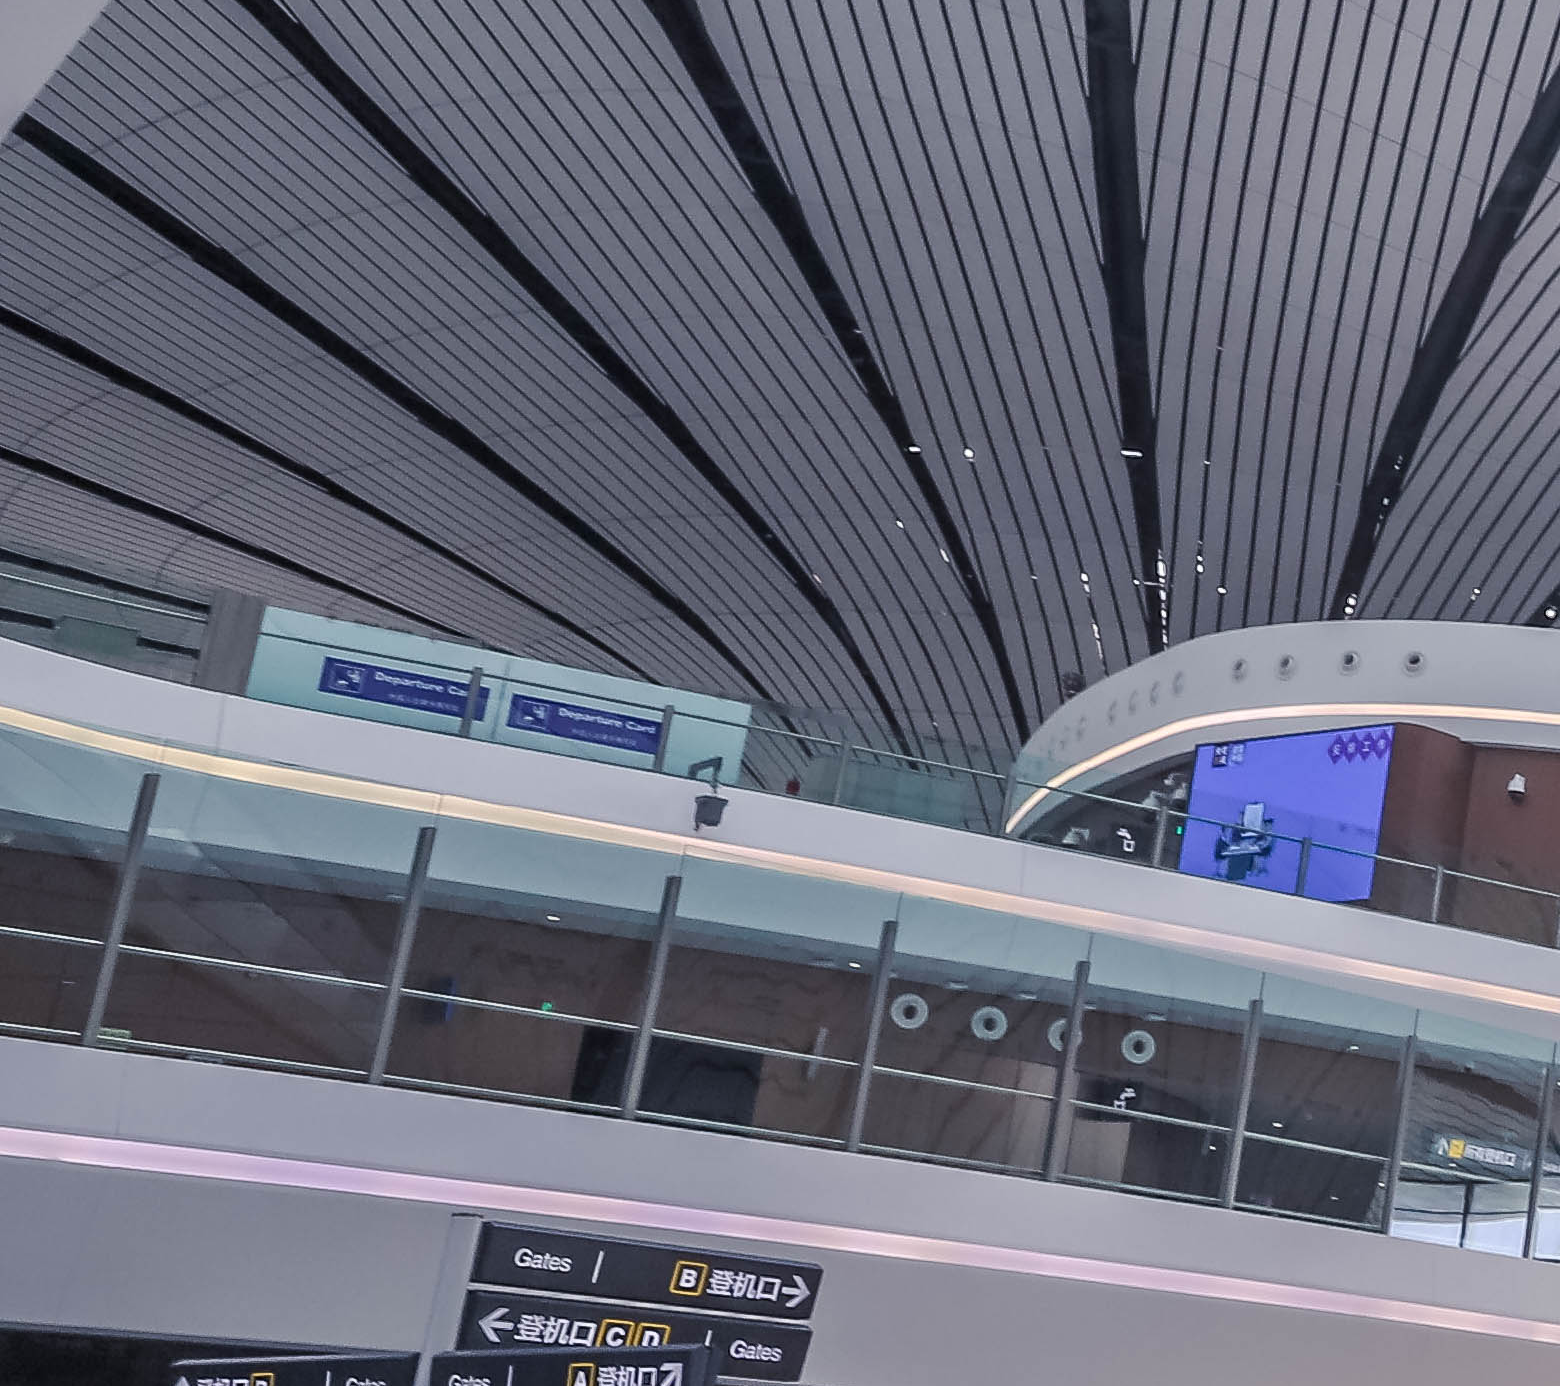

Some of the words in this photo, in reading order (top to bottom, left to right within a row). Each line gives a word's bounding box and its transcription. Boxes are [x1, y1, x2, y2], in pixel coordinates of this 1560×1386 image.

[514, 1248, 573, 1272] Gates
[679, 1270, 698, 1289] B
[707, 1268, 782, 1303] 登机口
[514, 1313, 598, 1348] 登机口
[605, 1328, 627, 1348] C
[729, 1339, 783, 1363] Gates
